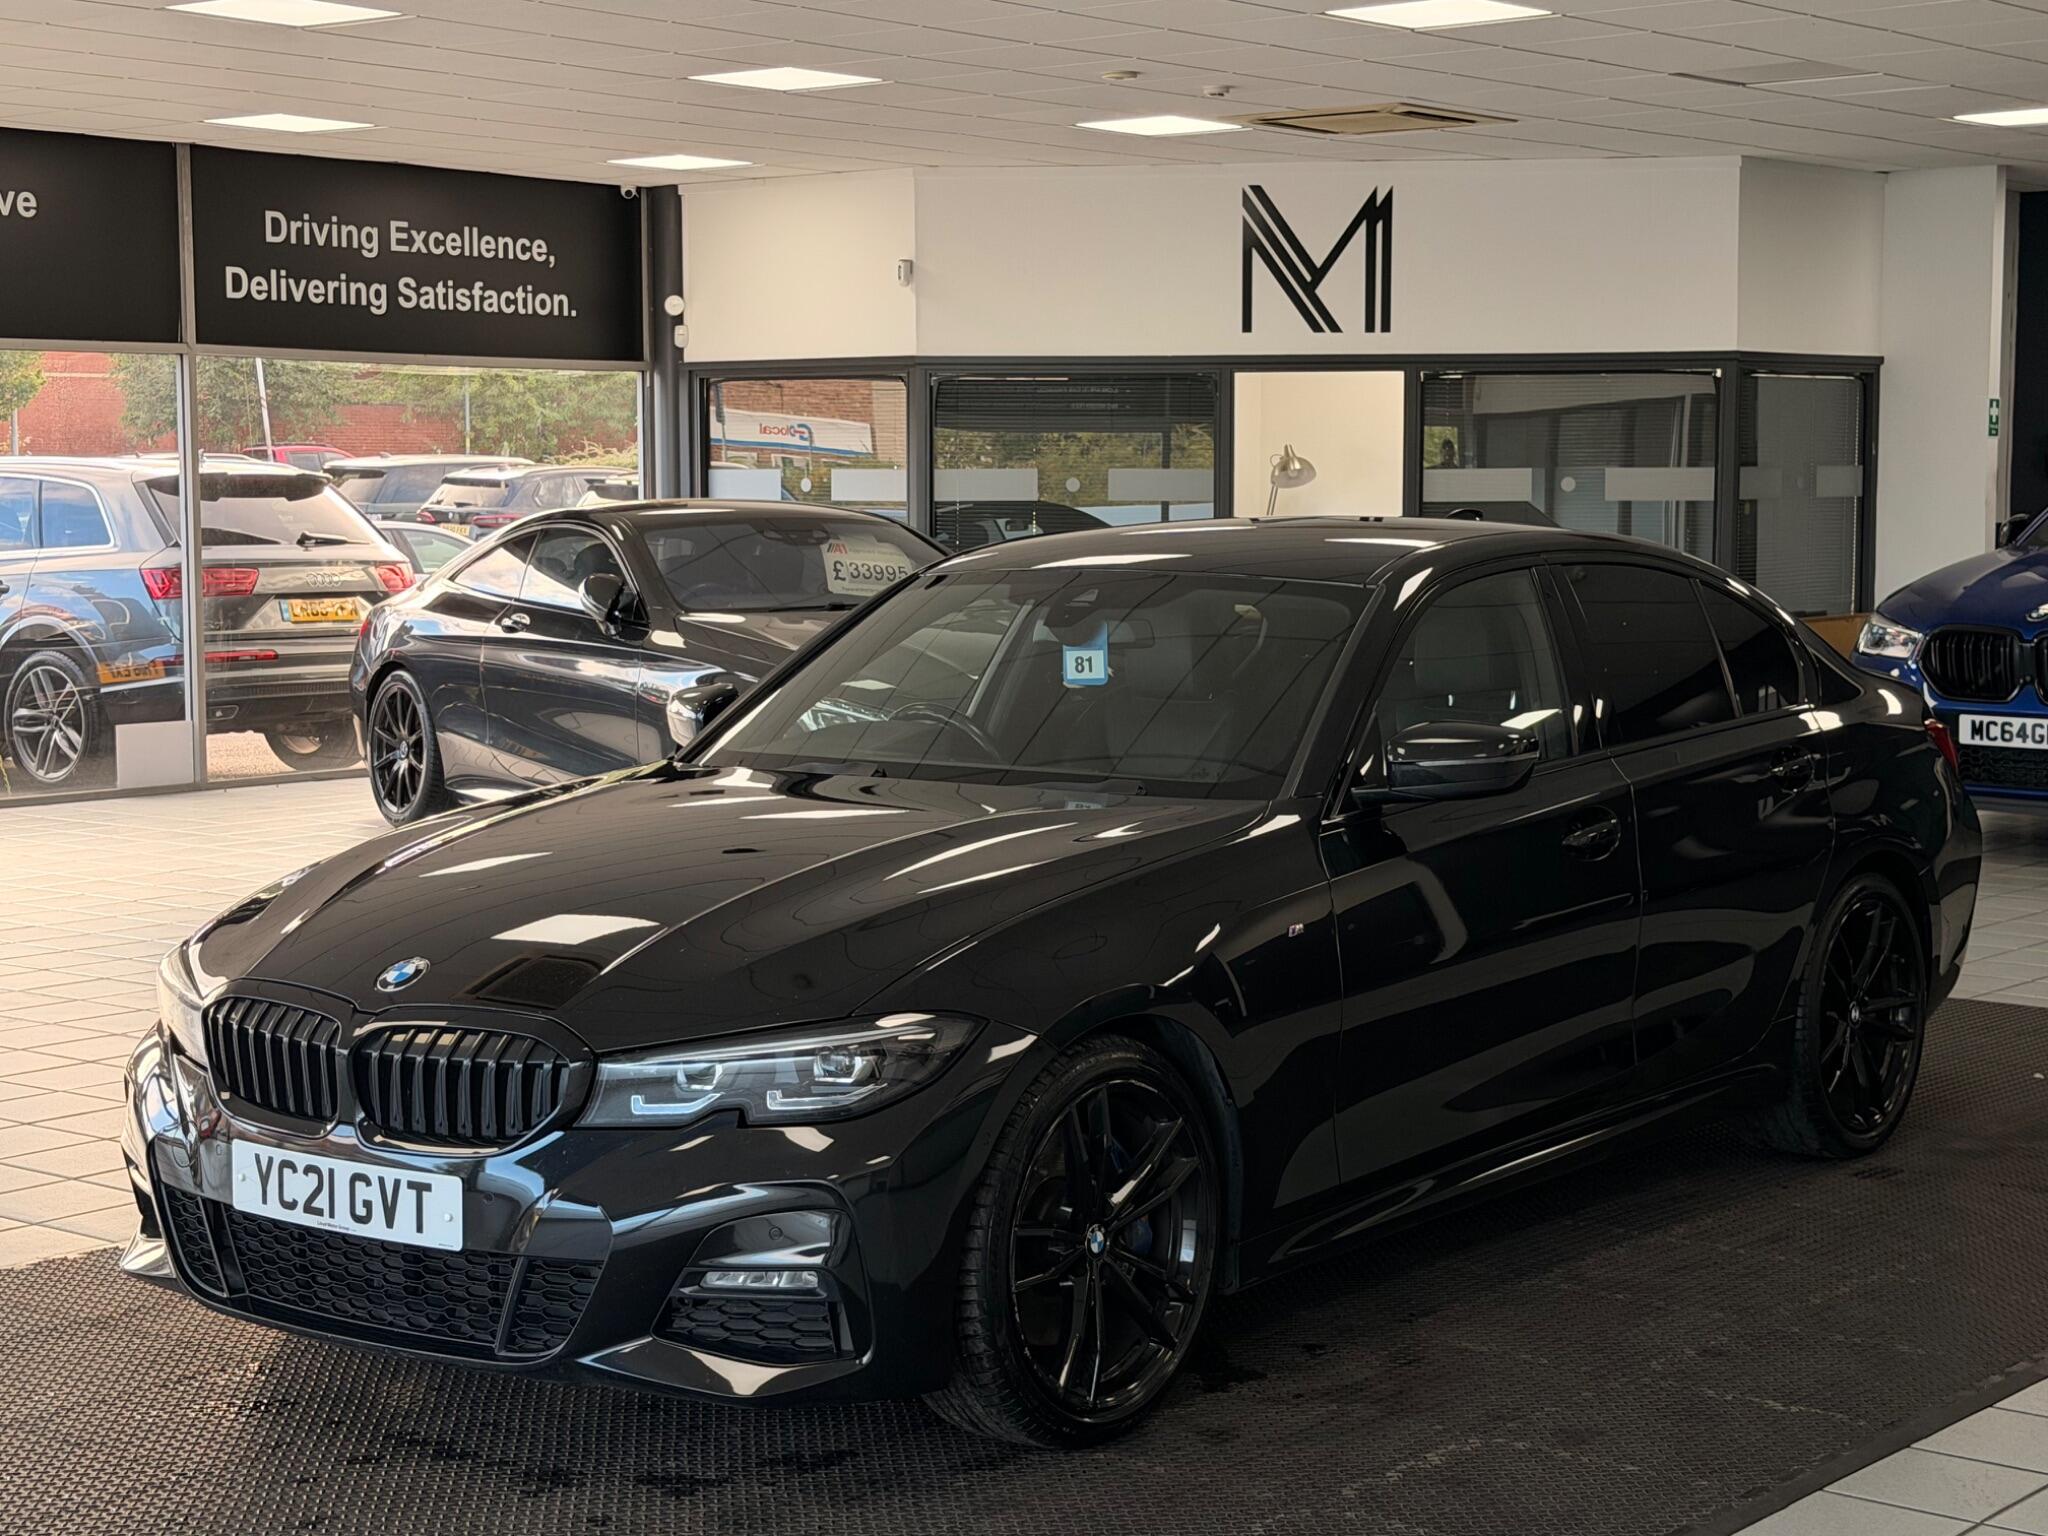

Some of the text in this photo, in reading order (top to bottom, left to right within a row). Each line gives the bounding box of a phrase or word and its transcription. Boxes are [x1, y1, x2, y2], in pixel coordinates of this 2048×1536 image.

[0, 191, 37, 218] ve
[265, 210, 556, 268] Driving Excellence,
[225, 266, 577, 317] Delivering Satisfaction.
[1075, 655, 1093, 673] 81
[1971, 719, 2048, 745] MC64G
[254, 1153, 432, 1234] YC21 GVT
